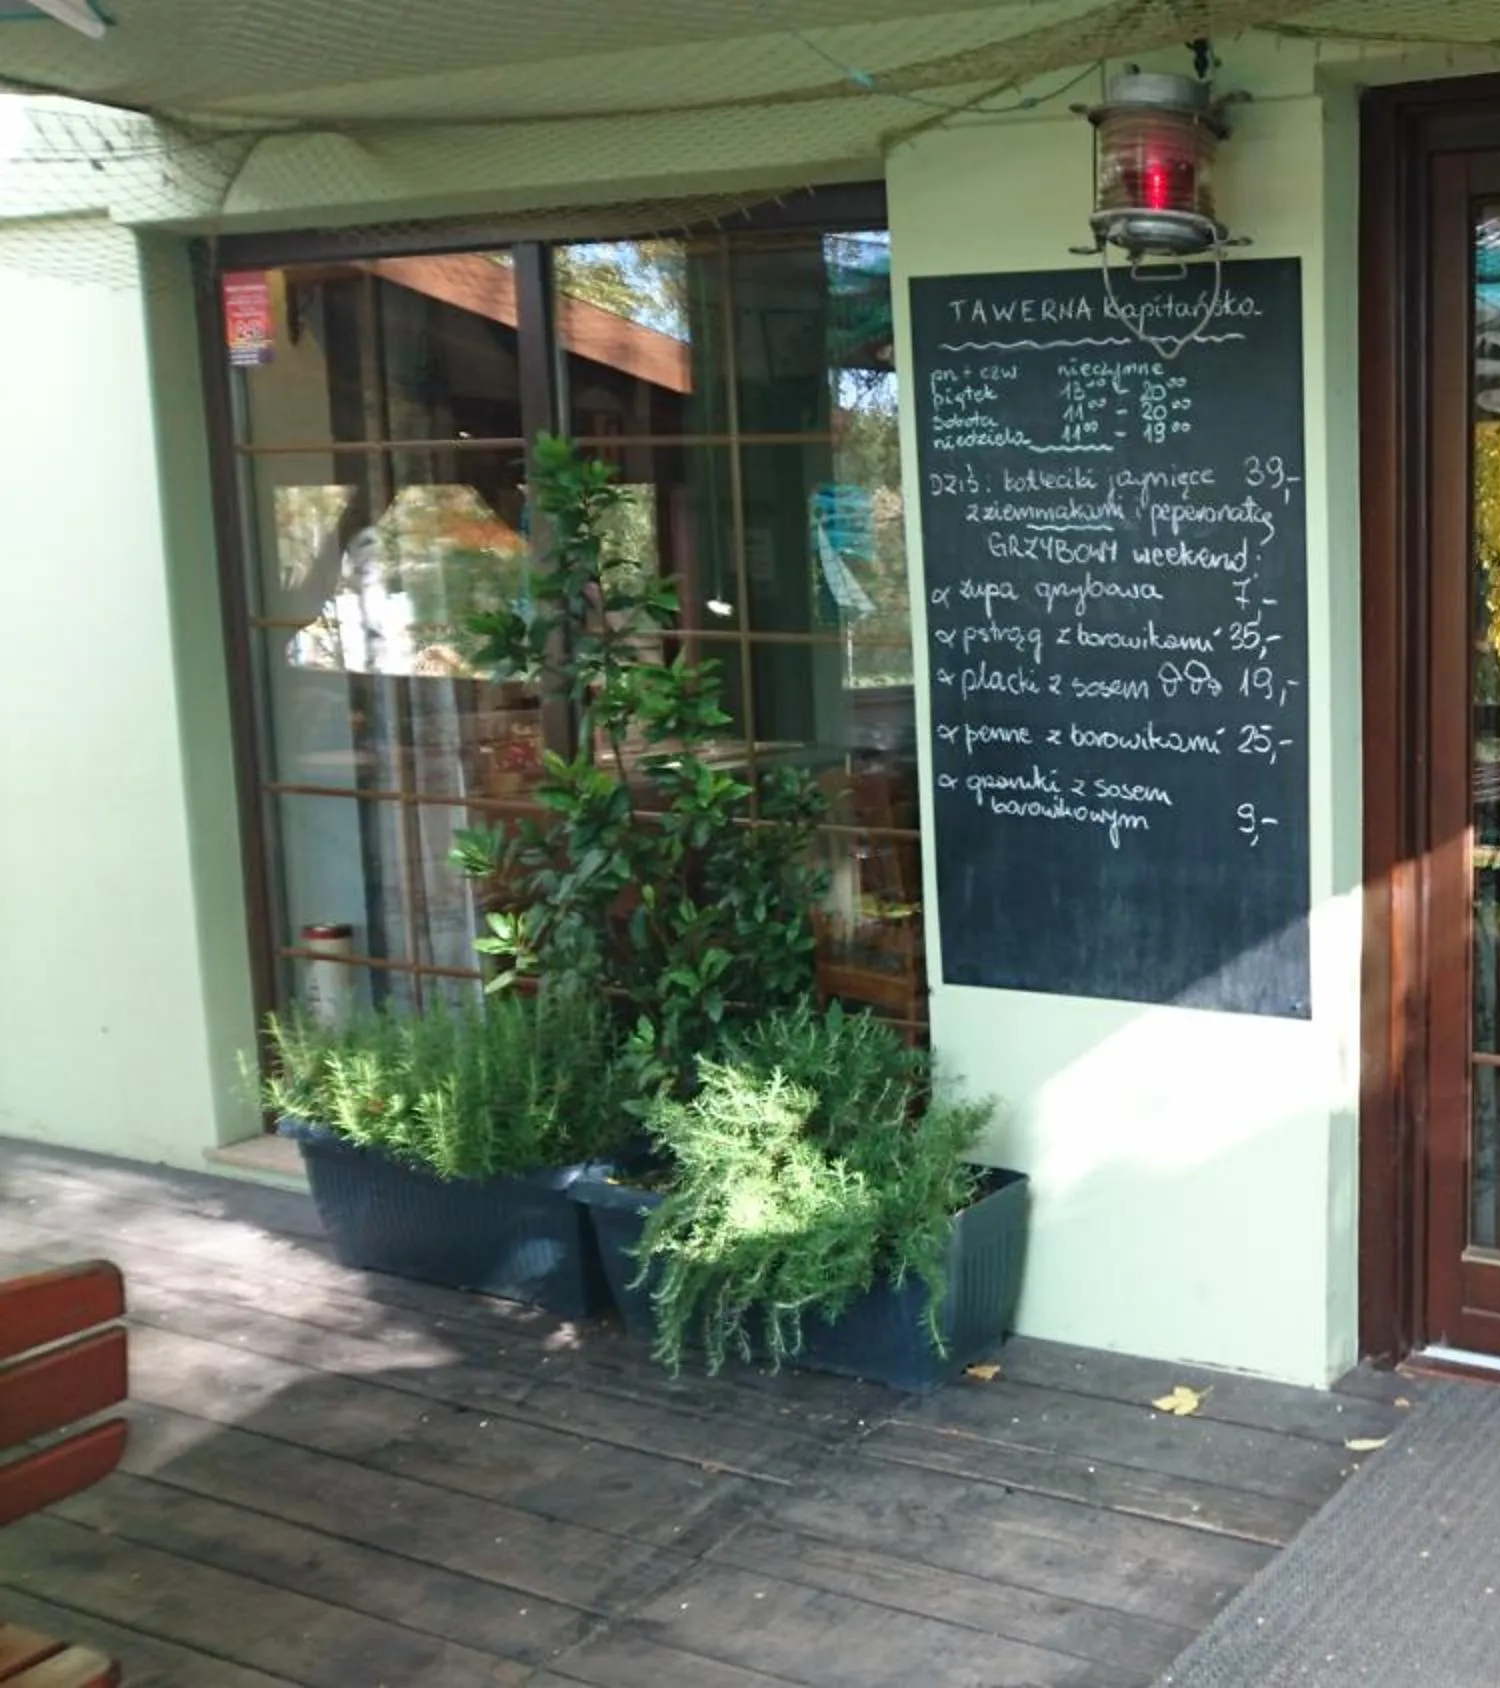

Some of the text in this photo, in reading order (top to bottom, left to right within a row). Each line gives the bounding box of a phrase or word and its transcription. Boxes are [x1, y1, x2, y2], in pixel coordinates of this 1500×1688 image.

[949, 299, 1092, 324] TAWERNA
[961, 660, 1040, 700] placki
[964, 723, 1033, 755] penne
[1071, 721, 1226, 756] borowikami
